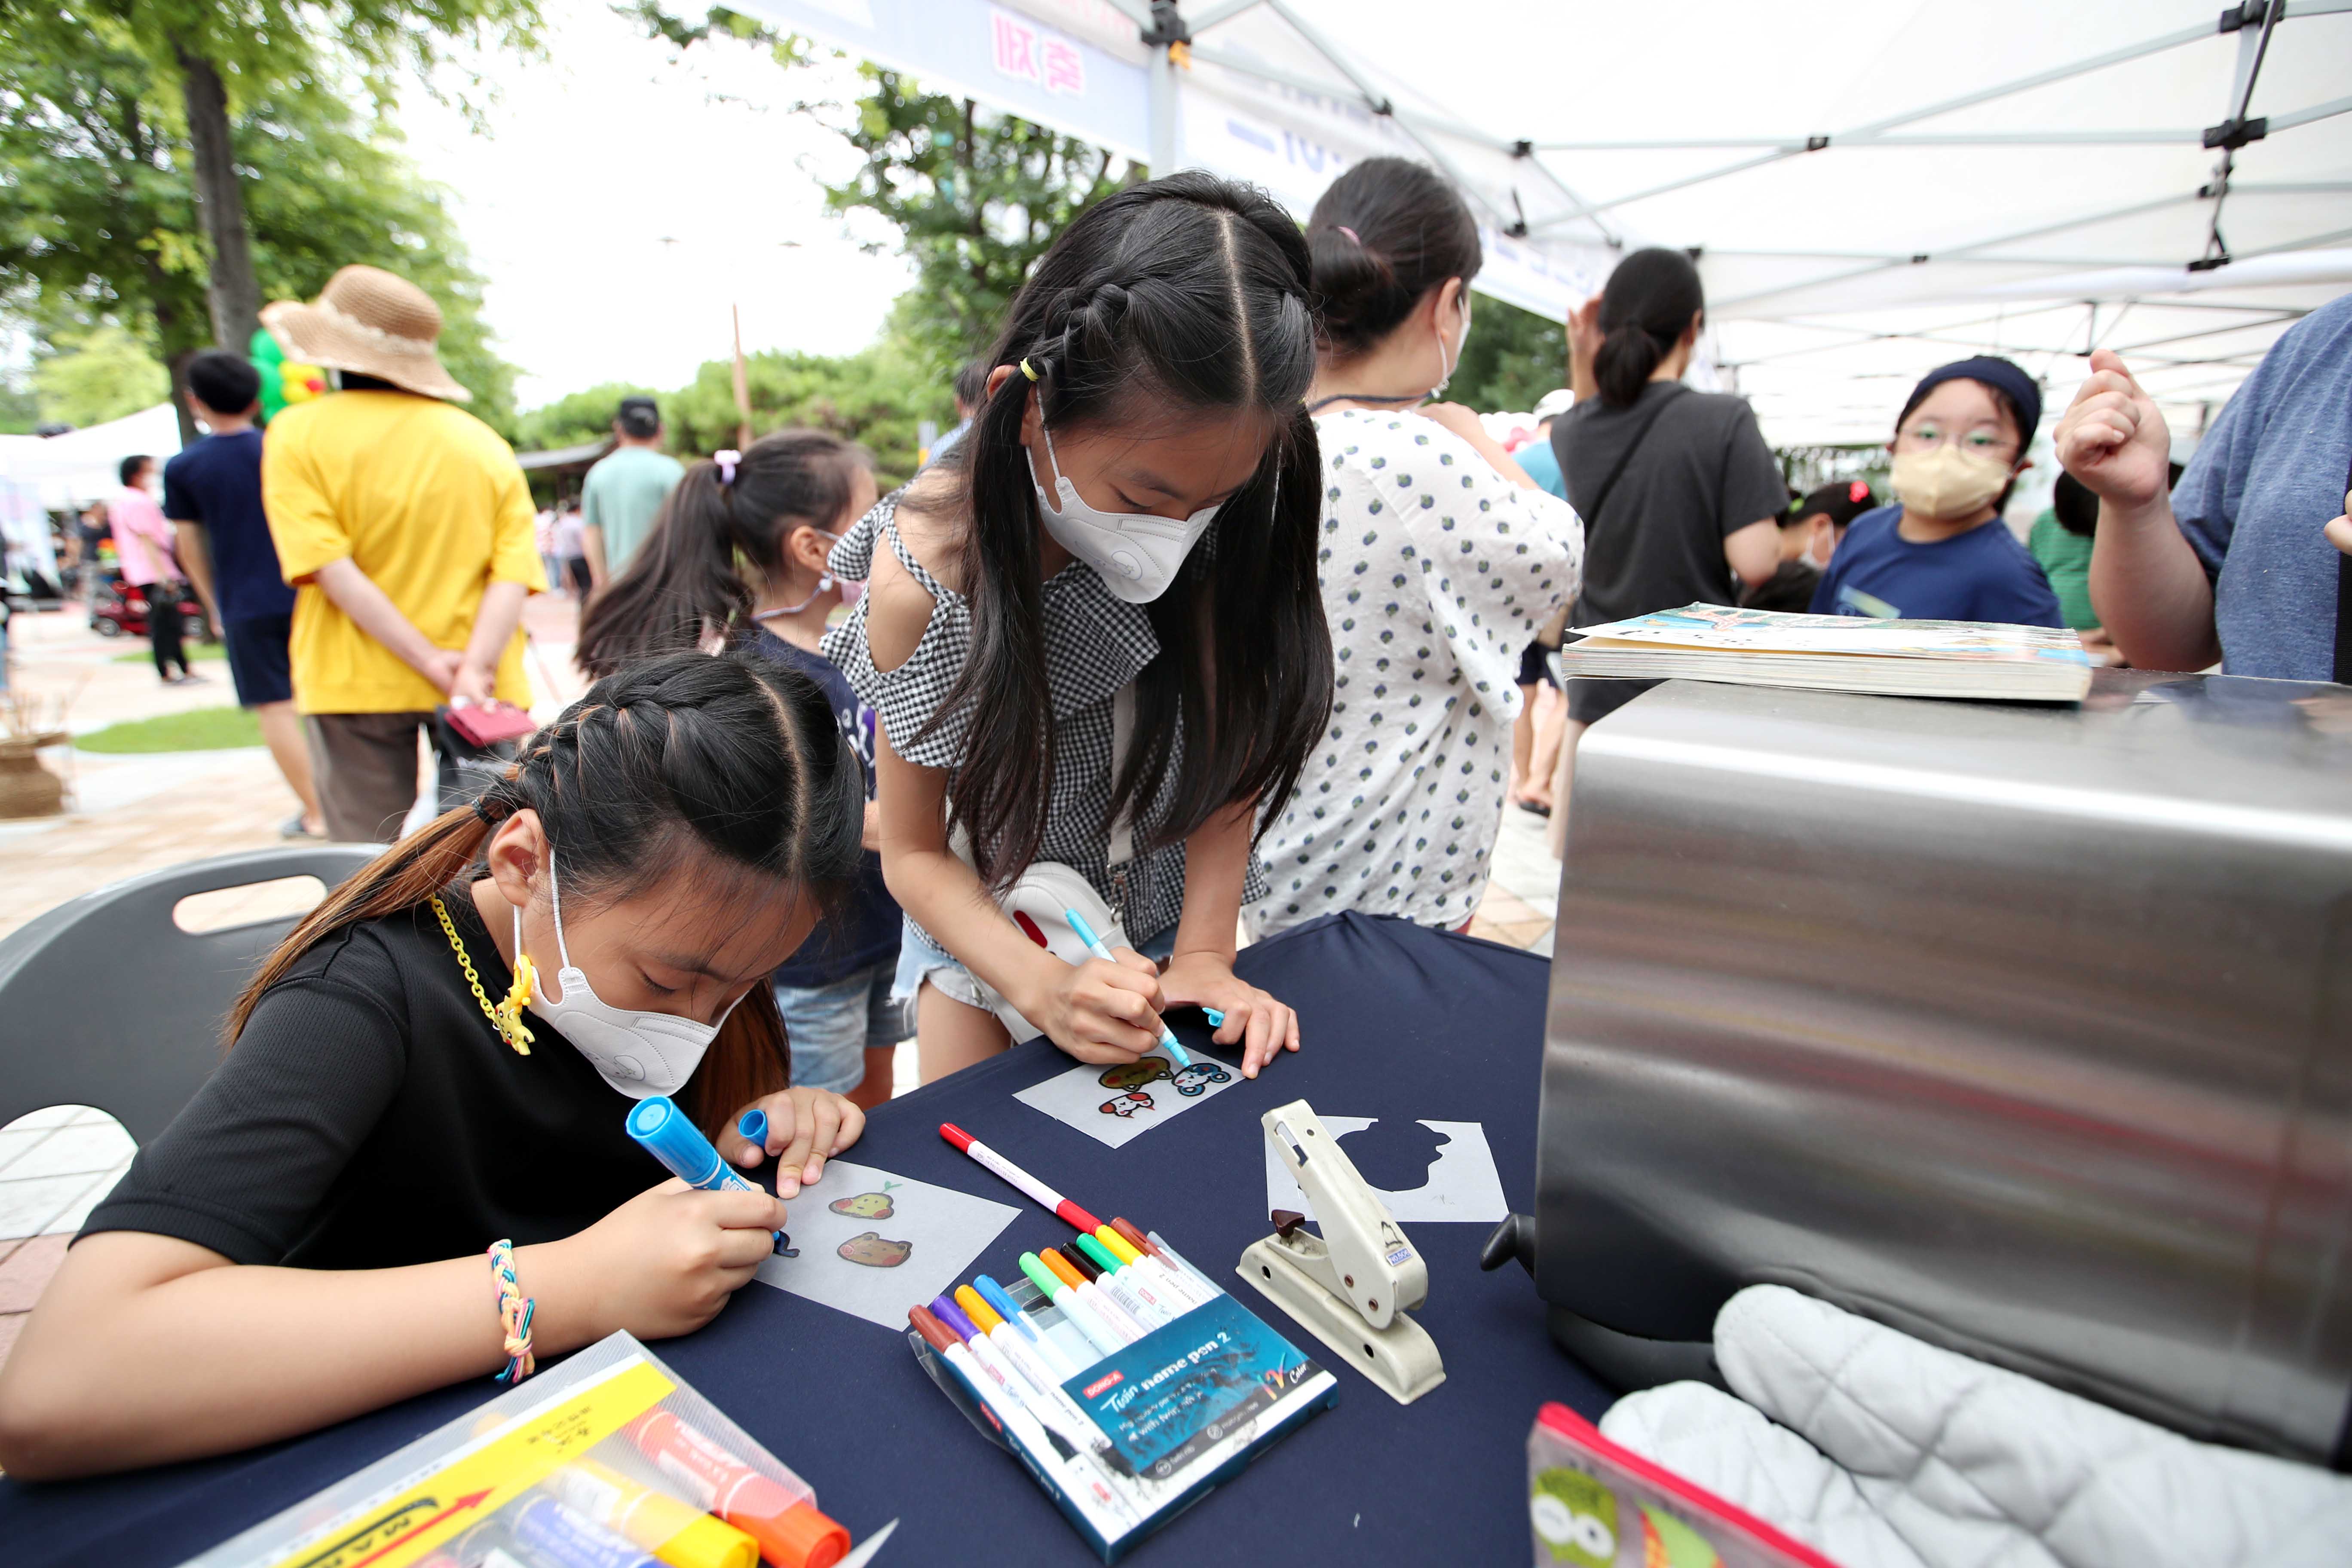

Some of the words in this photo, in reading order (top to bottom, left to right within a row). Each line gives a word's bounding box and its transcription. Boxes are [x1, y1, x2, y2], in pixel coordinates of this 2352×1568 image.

[1087, 1372, 1121, 1397] DONG-A
[1100, 1384, 1139, 1412] Twin
[1141, 1357, 1188, 1391] name
[1187, 1340, 1219, 1365] pen
[1216, 1331, 1231, 1344] 2
[1256, 1351, 1287, 1401] 12
[1289, 1363, 1308, 1384] Color
